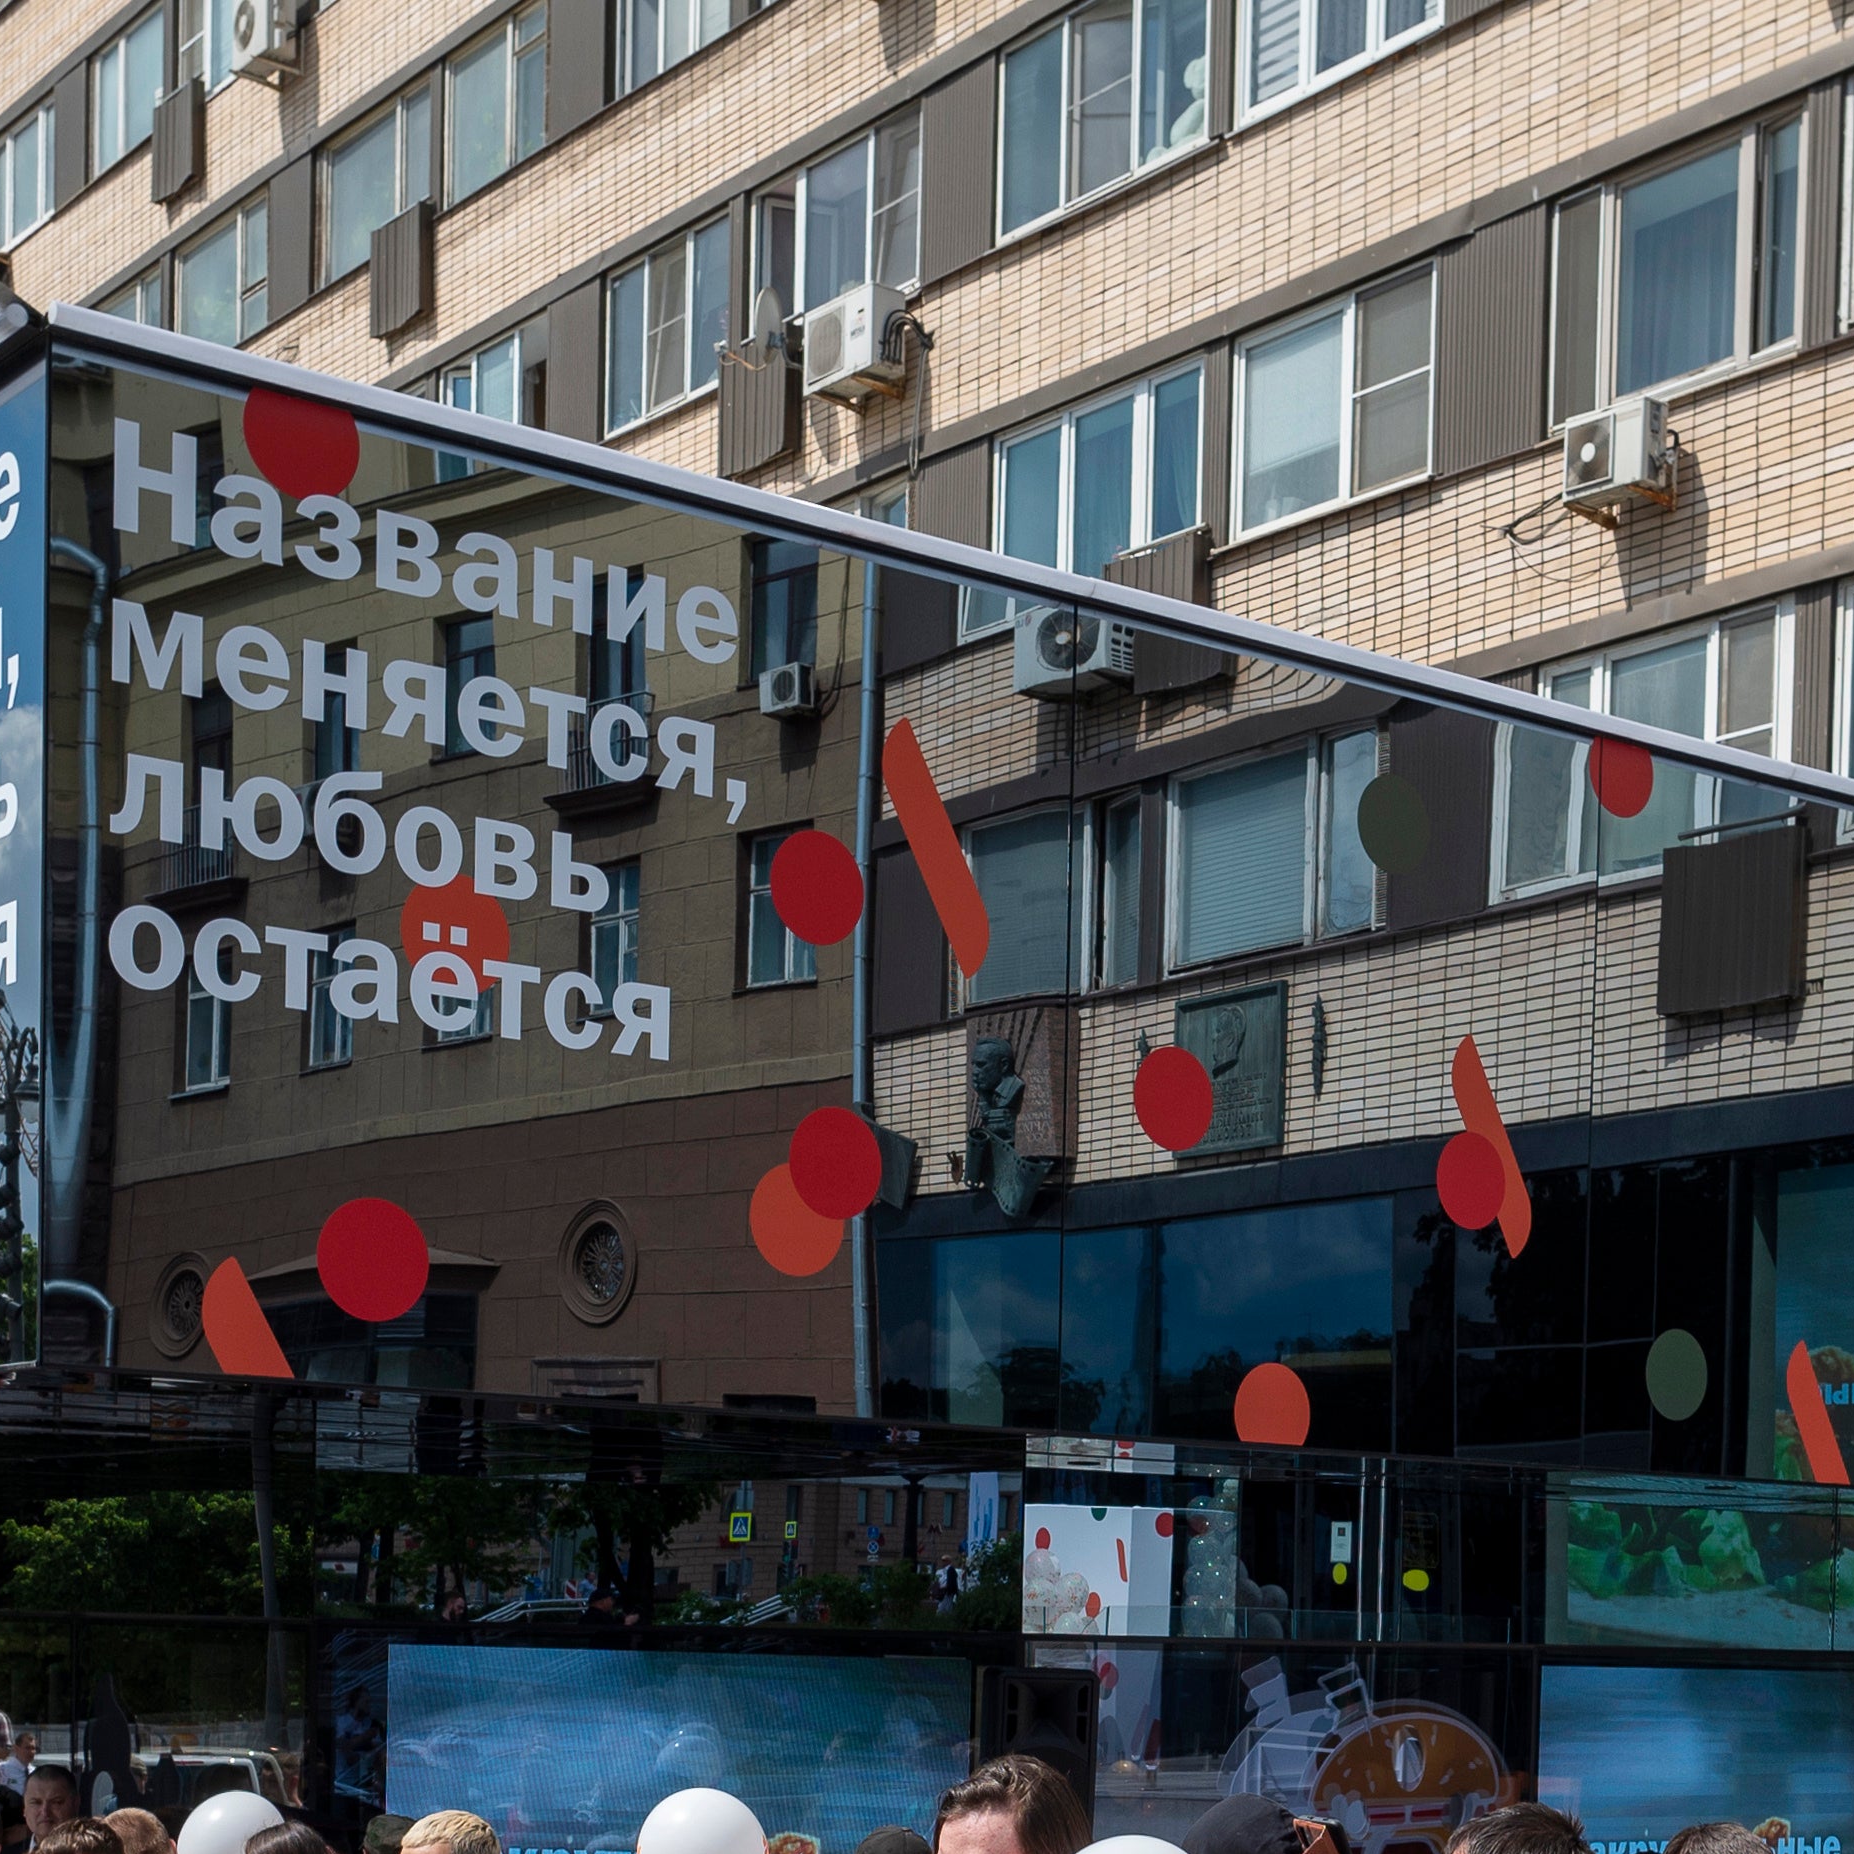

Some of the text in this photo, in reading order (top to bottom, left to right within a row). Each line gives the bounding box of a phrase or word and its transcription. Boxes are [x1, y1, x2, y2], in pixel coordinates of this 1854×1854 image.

[111, 416, 740, 665] Название
[111, 598, 749, 824] меняется,
[109, 754, 611, 912] любовь
[109, 904, 672, 1061] остаётся
